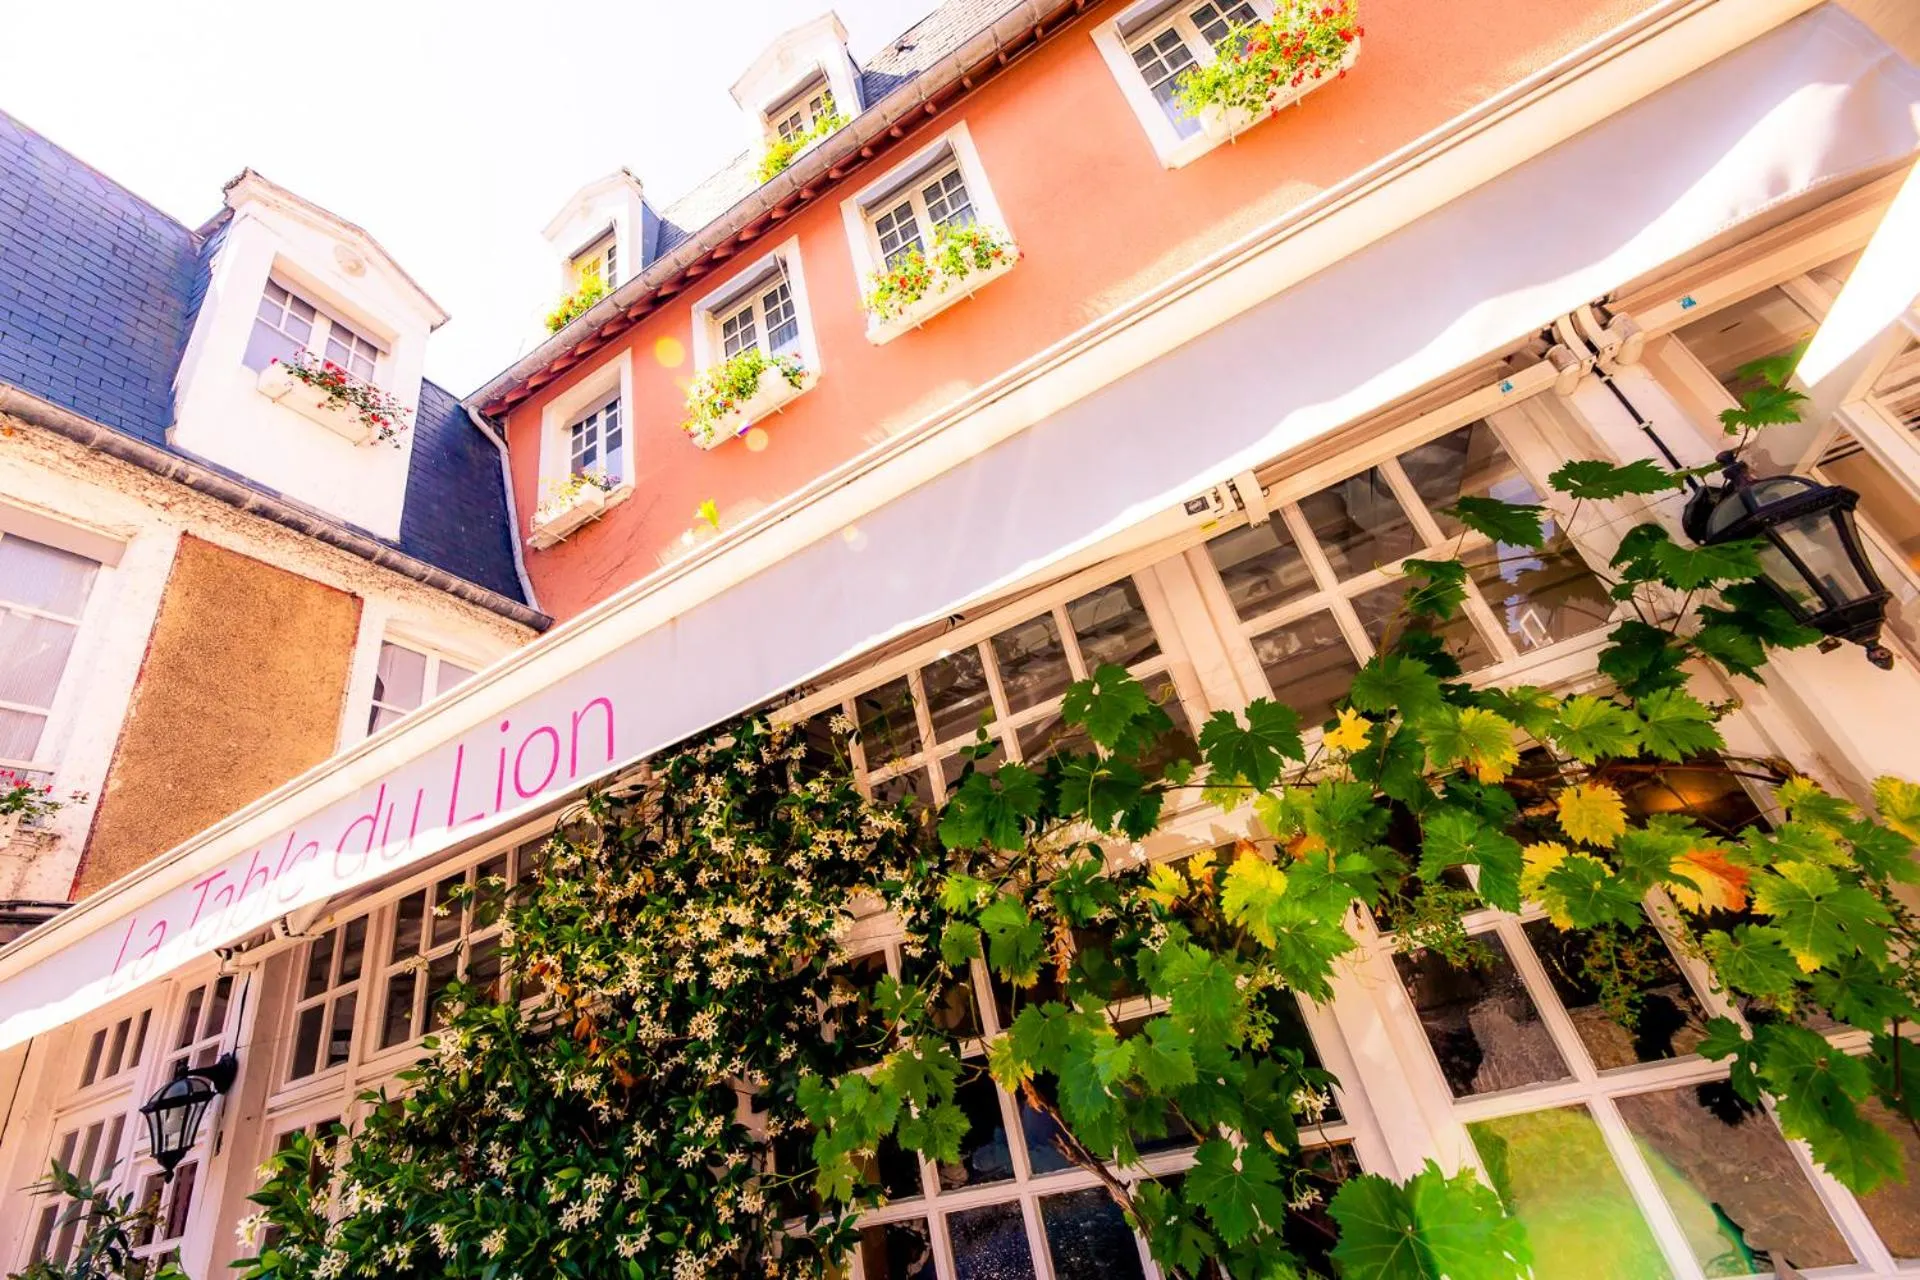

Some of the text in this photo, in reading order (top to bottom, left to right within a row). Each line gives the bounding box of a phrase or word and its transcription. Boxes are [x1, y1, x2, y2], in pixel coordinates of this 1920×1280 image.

[104, 697, 614, 994] La Table du Lion
